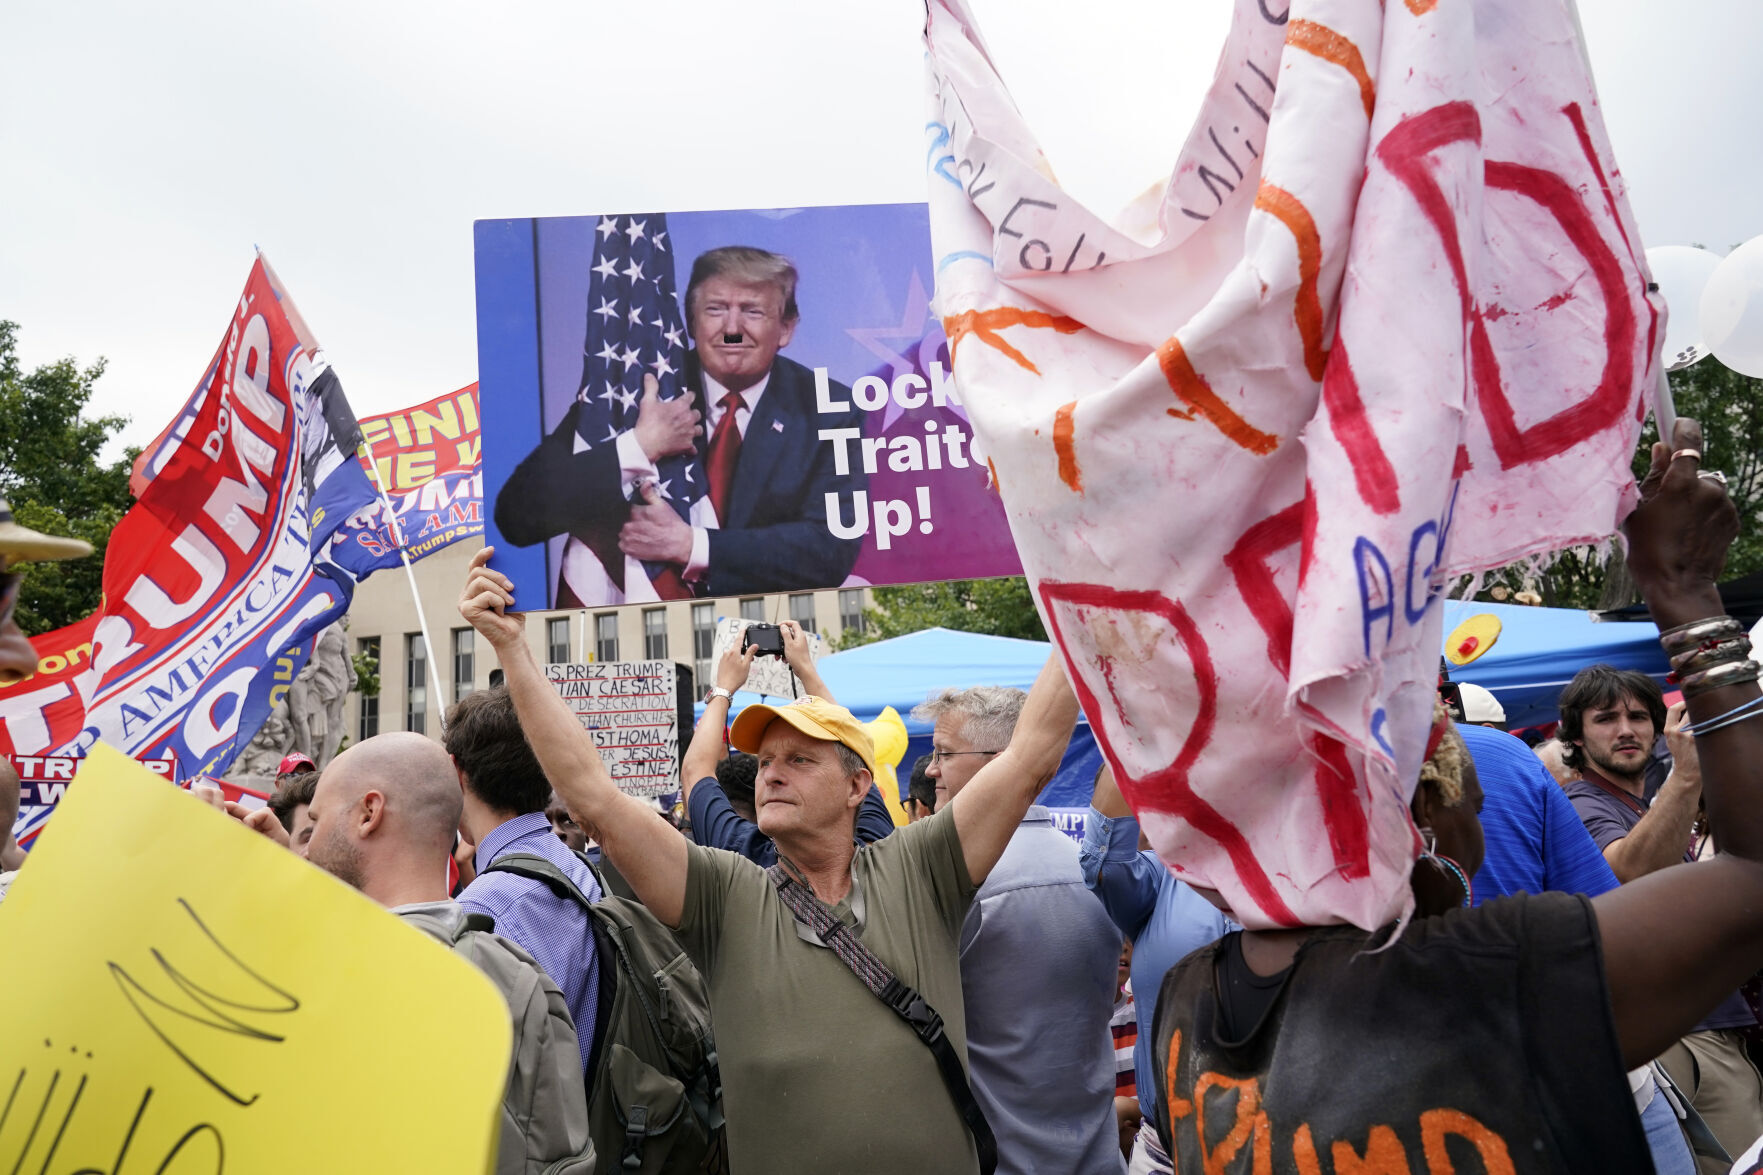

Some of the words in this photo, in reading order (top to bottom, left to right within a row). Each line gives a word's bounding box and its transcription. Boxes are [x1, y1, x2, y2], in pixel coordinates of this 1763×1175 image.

[813, 361, 962, 414] Lock
[357, 391, 480, 458] FINI
[0, 312, 287, 757] TRUMP
[824, 486, 934, 551] Up!
[552, 681, 591, 697] TIAN
[578, 696, 670, 711] DESECRATION
[15, 757, 171, 779] TRP
